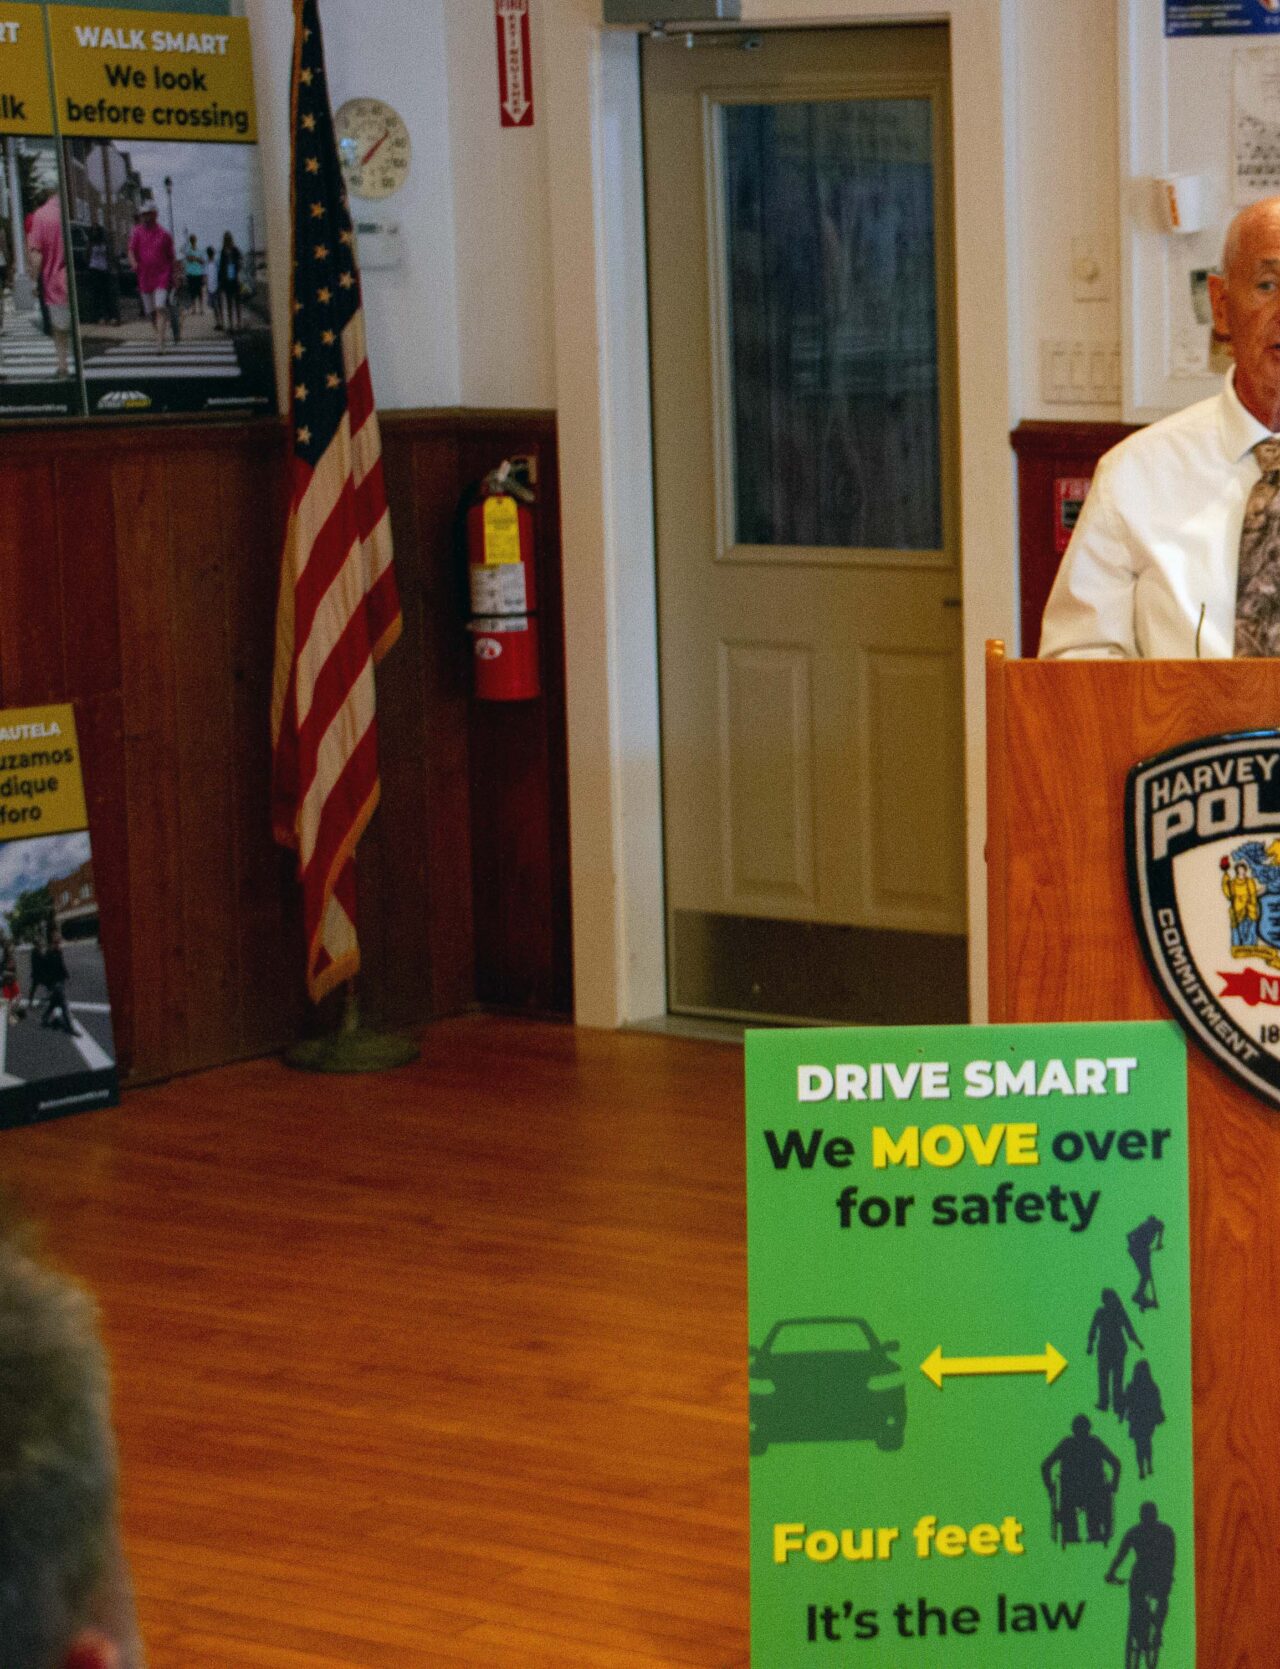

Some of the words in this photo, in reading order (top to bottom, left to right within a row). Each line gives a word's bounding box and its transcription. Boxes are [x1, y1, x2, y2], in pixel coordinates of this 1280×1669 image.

[75, 26, 147, 50] WALK
[151, 31, 229, 55] SMART
[105, 64, 146, 88] We
[154, 66, 207, 91] look
[66, 97, 146, 125] before
[152, 102, 249, 133] crossing
[1152, 754, 1279, 809] HARVEY
[1158, 908, 1260, 1061] COMMITMENT
[797, 1062, 950, 1102] DRIVE
[964, 1057, 1137, 1098] SMART
[764, 1129, 855, 1169] We
[872, 1122, 1040, 1169] MOVE
[1051, 1128, 1171, 1162] over
[836, 1186, 915, 1228] for
[932, 1182, 1100, 1233] safety
[773, 1523, 899, 1564] Four
[913, 1515, 1024, 1558] feet
[893, 1597, 980, 1637] the
[997, 1593, 1086, 1633] law
